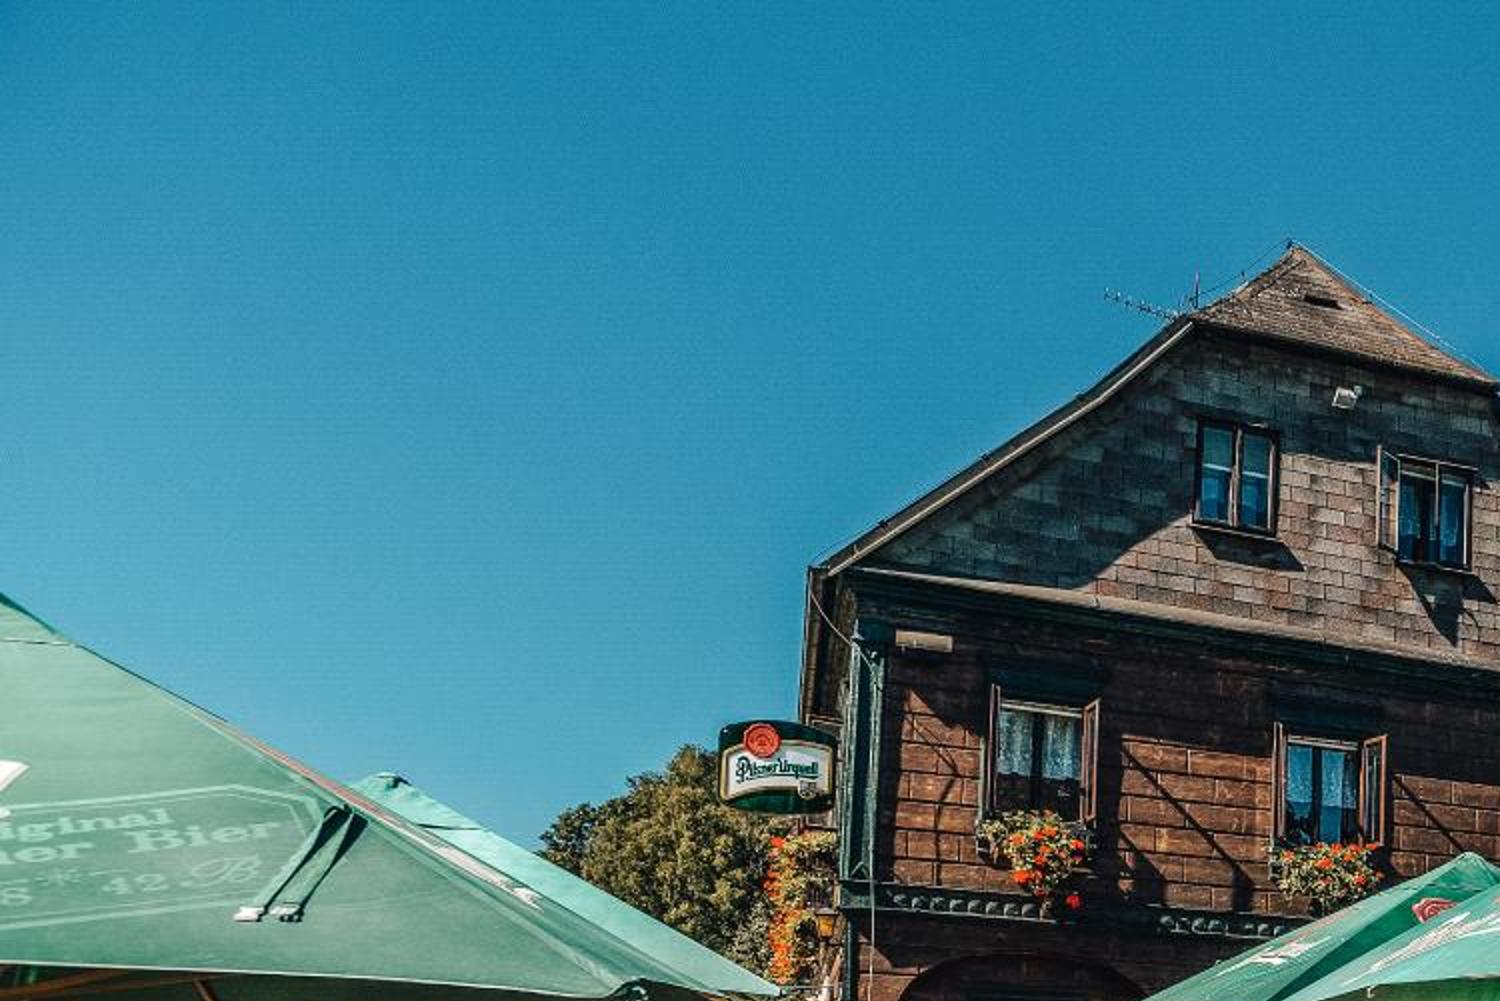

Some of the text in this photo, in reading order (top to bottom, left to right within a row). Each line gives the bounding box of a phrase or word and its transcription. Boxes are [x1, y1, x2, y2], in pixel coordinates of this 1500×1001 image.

[735, 756, 819, 784] Pilsner Urquell
[127, 821, 281, 854] Bier
